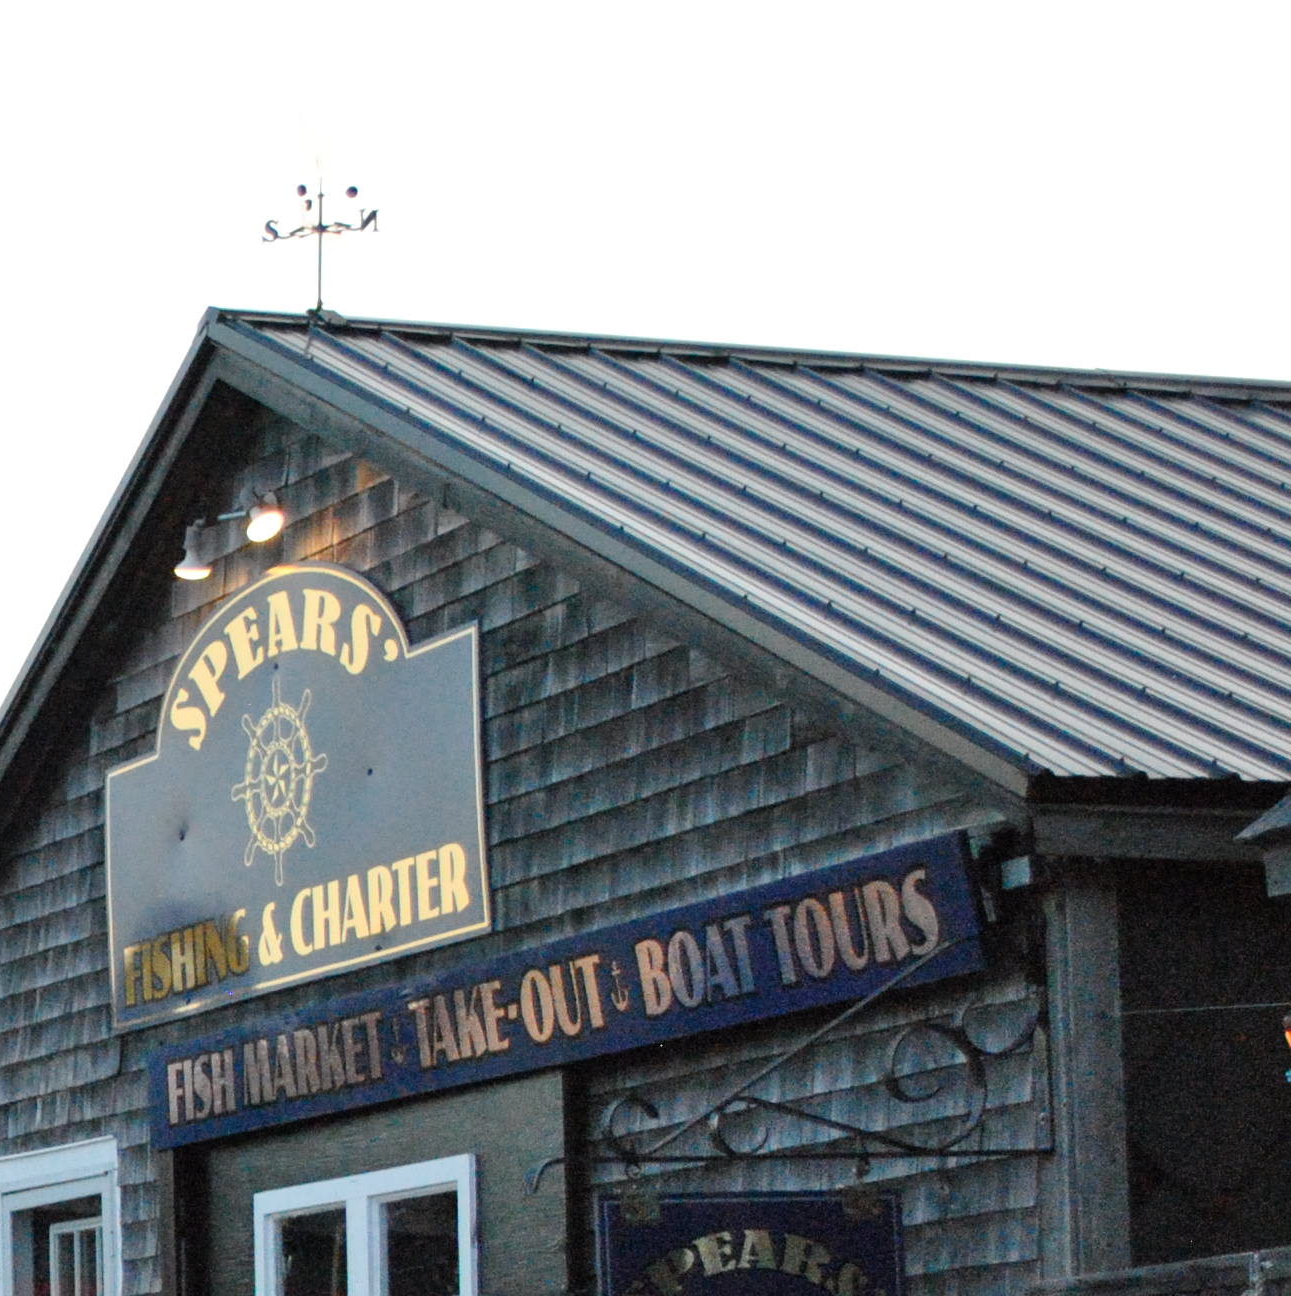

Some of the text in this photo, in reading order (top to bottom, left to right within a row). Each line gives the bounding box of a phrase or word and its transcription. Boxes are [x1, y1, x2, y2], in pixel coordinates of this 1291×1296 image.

[122, 843, 471, 1007] FISHING & CHARTER
[166, 868, 940, 1125] FISH MARKET TAKE-OUT BOAT TOURS
